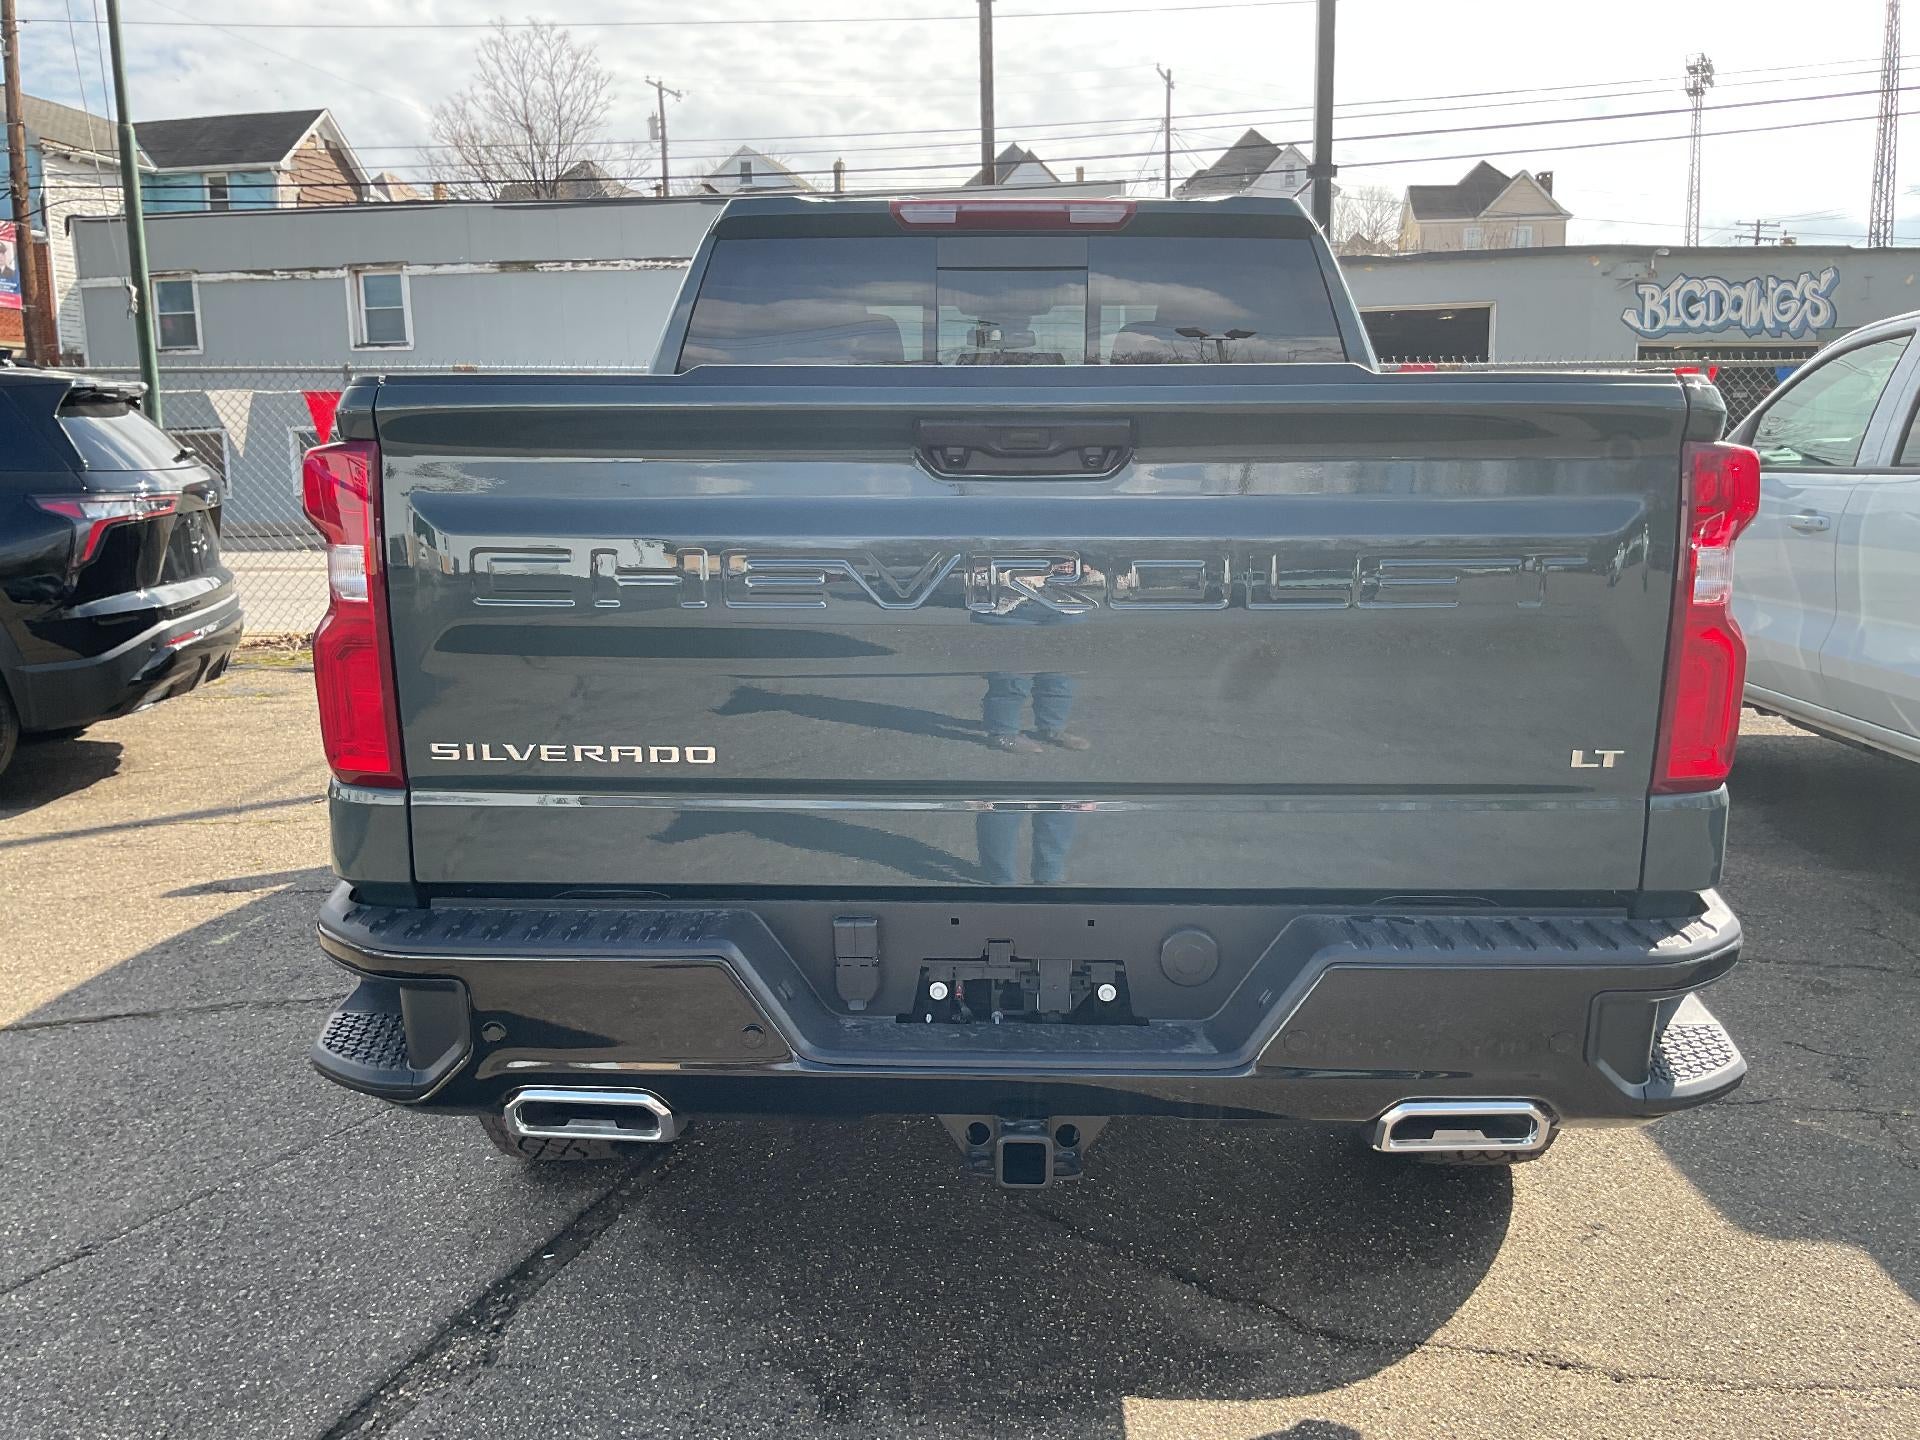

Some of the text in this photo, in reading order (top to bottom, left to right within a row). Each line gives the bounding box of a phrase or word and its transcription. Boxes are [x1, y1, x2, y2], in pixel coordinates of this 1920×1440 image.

[469, 549, 1590, 609] CHEVROLET
[429, 743, 717, 764] SILVERADO
[1570, 749, 1625, 768] LT
